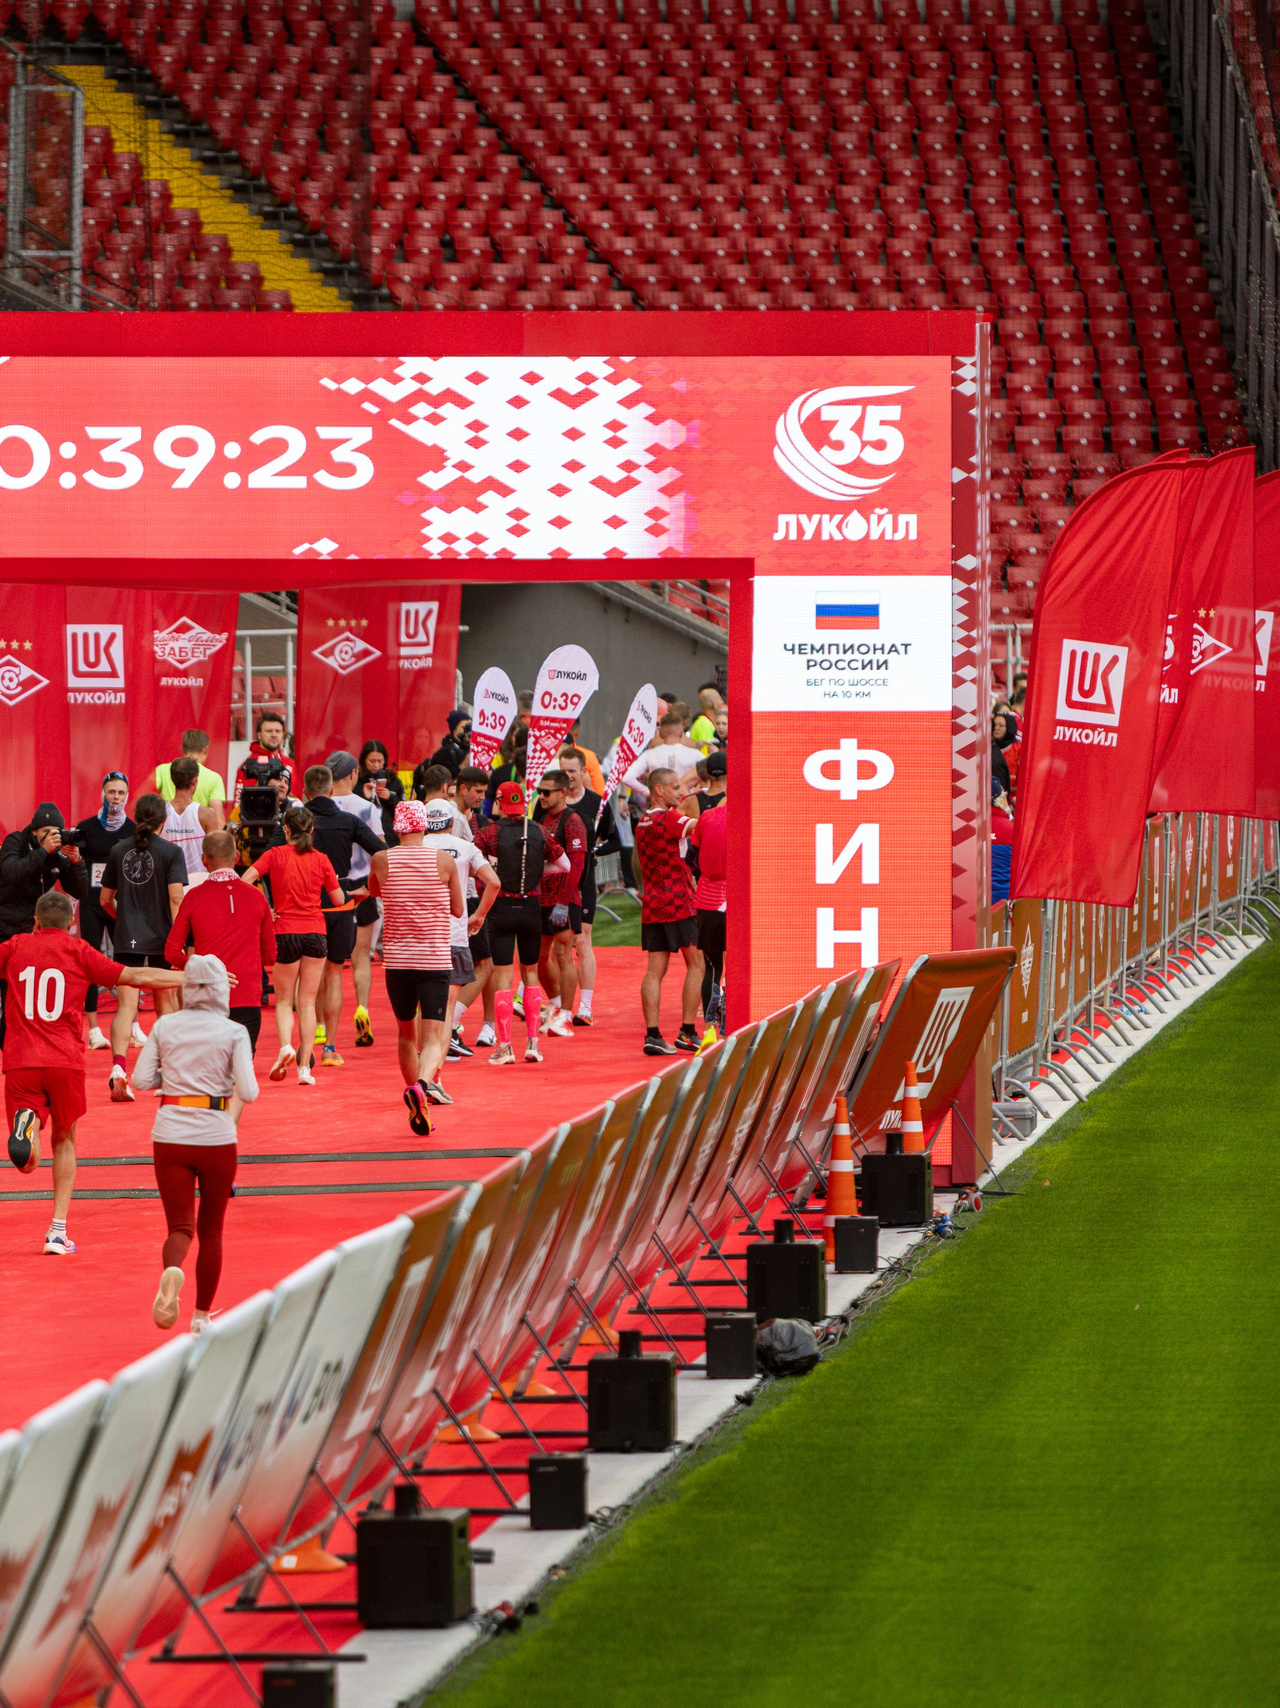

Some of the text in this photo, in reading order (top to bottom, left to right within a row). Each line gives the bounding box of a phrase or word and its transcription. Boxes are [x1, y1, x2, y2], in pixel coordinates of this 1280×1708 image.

[818, 404, 905, 465] 35
[773, 507, 918, 541] ЛУКОЙЛ
[157, 646, 213, 659] ЗАБЕГ
[783, 643, 912, 656] ЧЕМПИОНАТ
[399, 656, 433, 669] УКОЙЛ
[806, 658, 889, 671] РОССИИ
[160, 676, 204, 687] ЛУКОЙЛ
[556, 669, 587, 683] ЛУКОЙЛ
[806, 678, 888, 687] БЕГ ПО ШОССЕ
[823, 690, 871, 698] НА 10 КМ
[540, 690, 582, 713] 0:39
[1053, 726, 1118, 747] ЛУКОЙЛ
[18, 966, 66, 1022] 10
[879, 1109, 903, 1130] ЛУК
